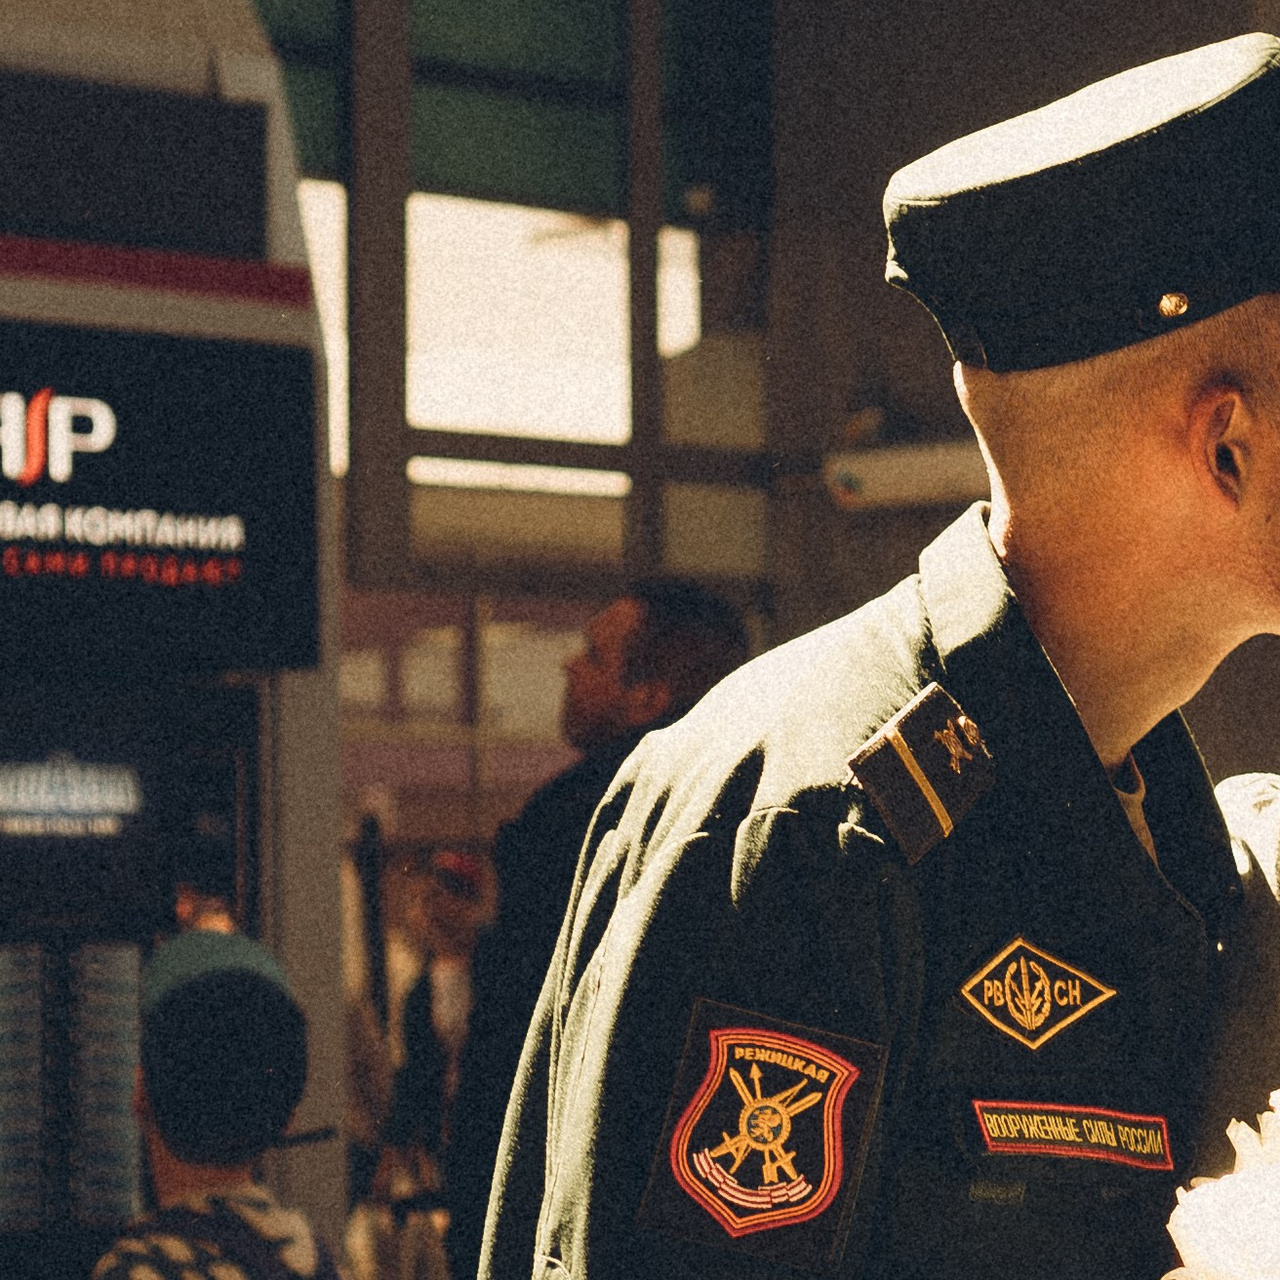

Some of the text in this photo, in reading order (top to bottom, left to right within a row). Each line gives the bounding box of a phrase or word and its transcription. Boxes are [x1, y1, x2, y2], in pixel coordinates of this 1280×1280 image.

[64, 503, 244, 552] КОМПАНИЯ
[733, 1045, 830, 1084] РЕЖИЦКАЯ
[984, 1111, 1164, 1155] ВООРУЖЕННЫЕ СИЛЫ РОССИИ
